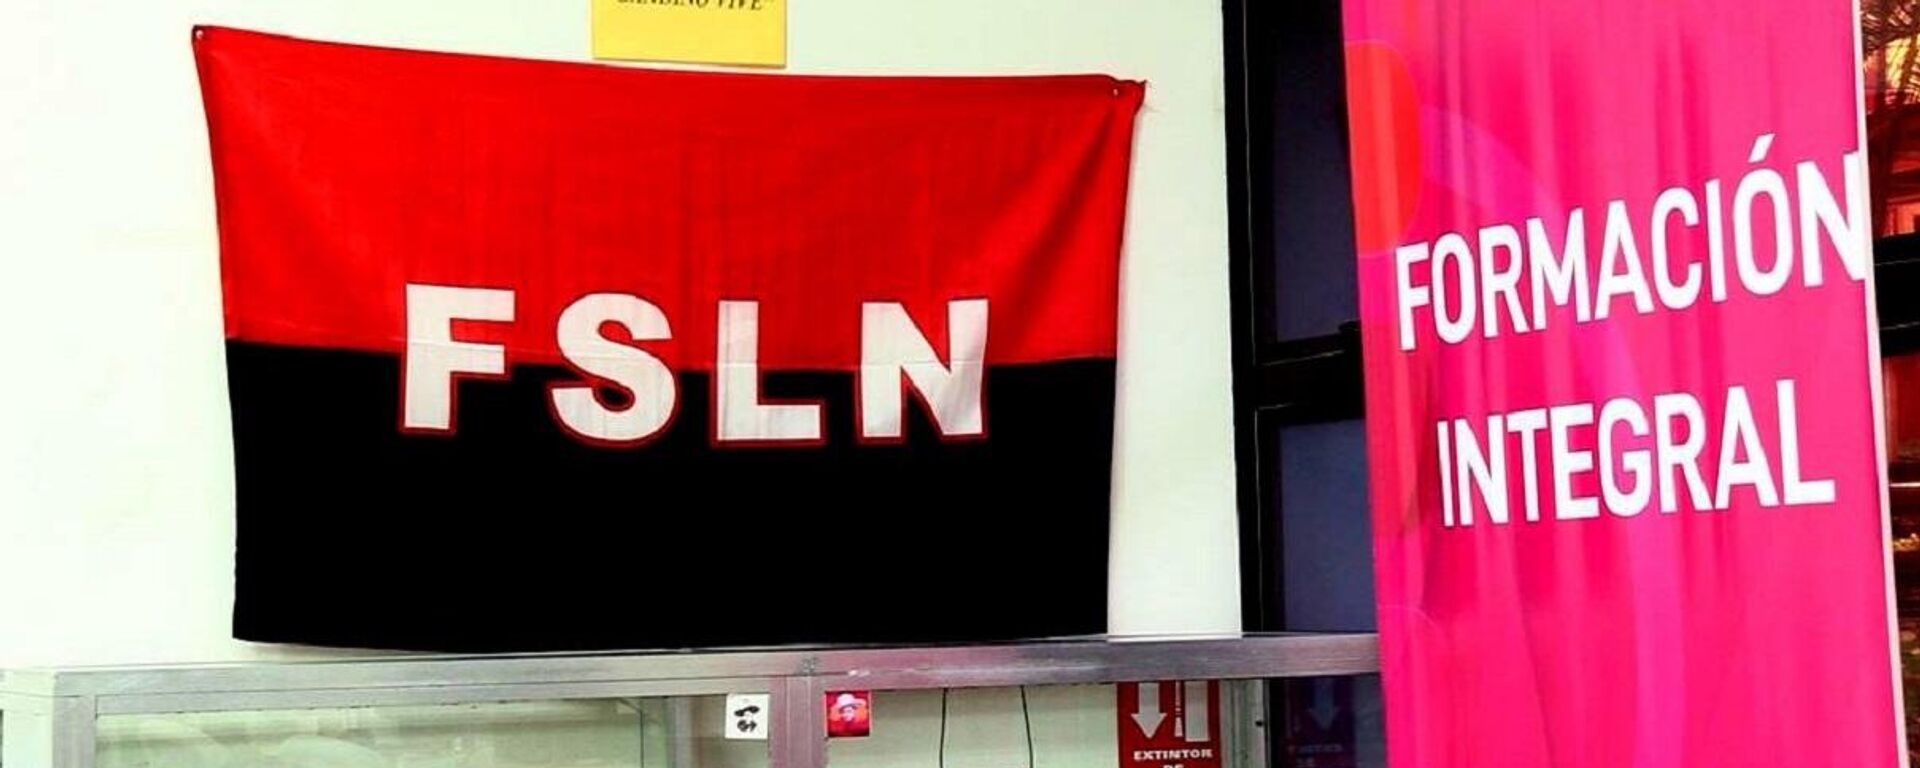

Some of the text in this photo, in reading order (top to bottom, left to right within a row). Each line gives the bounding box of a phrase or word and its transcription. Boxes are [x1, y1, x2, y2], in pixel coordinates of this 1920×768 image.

[1396, 133, 1866, 351] FORMACIÓN
[403, 282, 989, 442] FSLN
[1436, 379, 1836, 527] INTEGRAL
[1133, 748, 1213, 761] EXTINTOR
